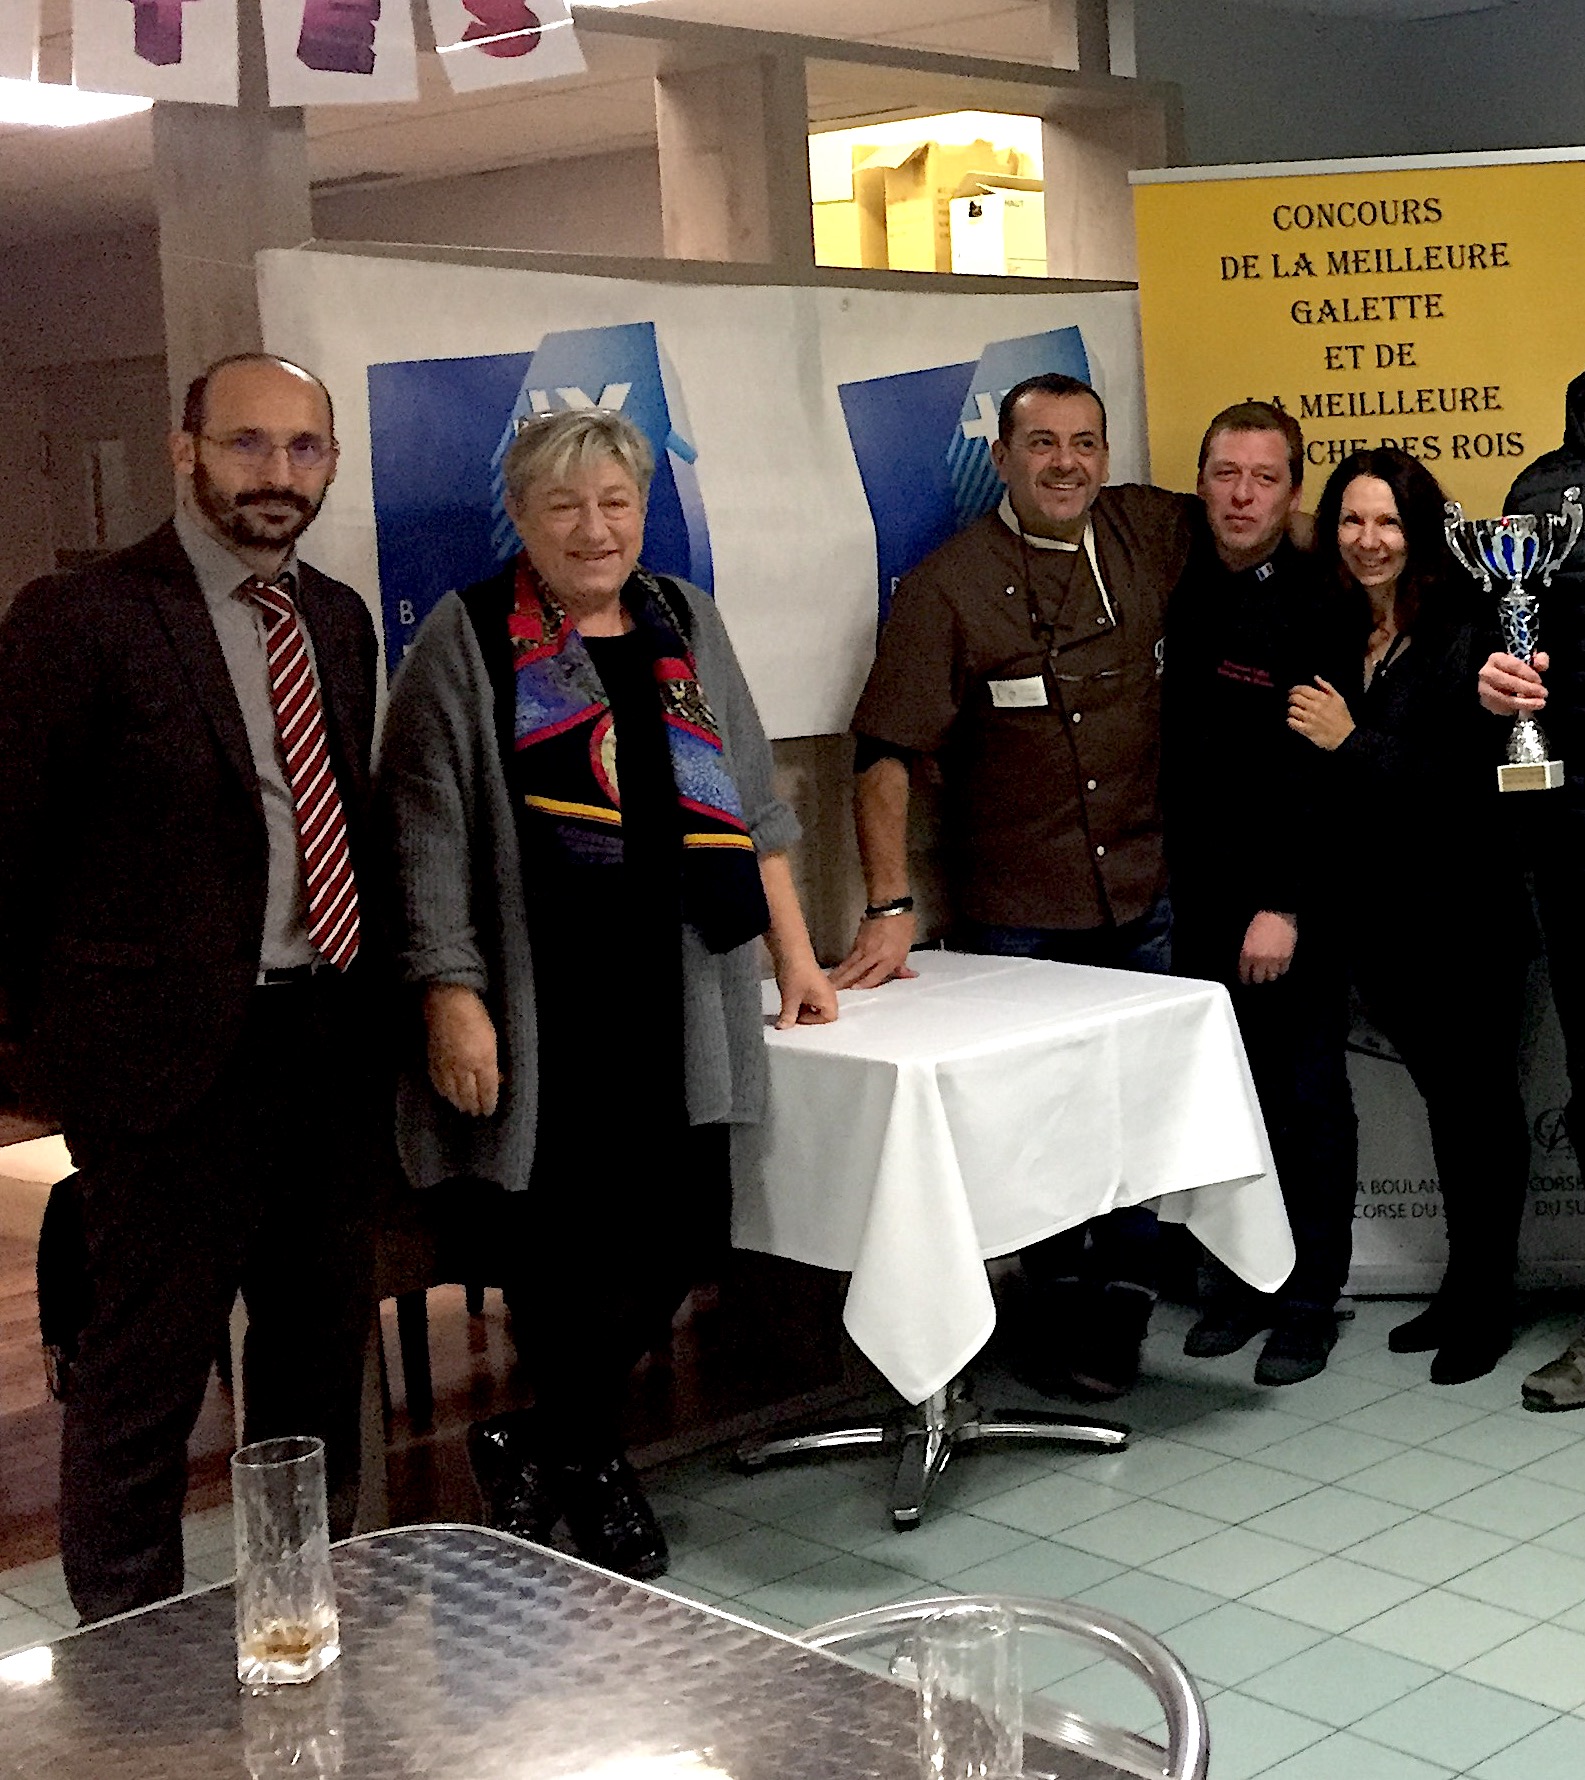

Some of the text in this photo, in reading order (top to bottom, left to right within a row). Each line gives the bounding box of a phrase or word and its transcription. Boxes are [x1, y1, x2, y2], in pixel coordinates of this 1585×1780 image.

[1273, 197, 1443, 231] CONCOURS
[1221, 241, 1511, 282] DE LA MEILLEURE
[1291, 293, 1445, 325] GALETTE
[1324, 341, 1417, 371] ET DE
[1452, 432, 1525, 459] ROIS
[1353, 1203, 1407, 1219] CORSE
[1411, 1203, 1437, 1218] DU
